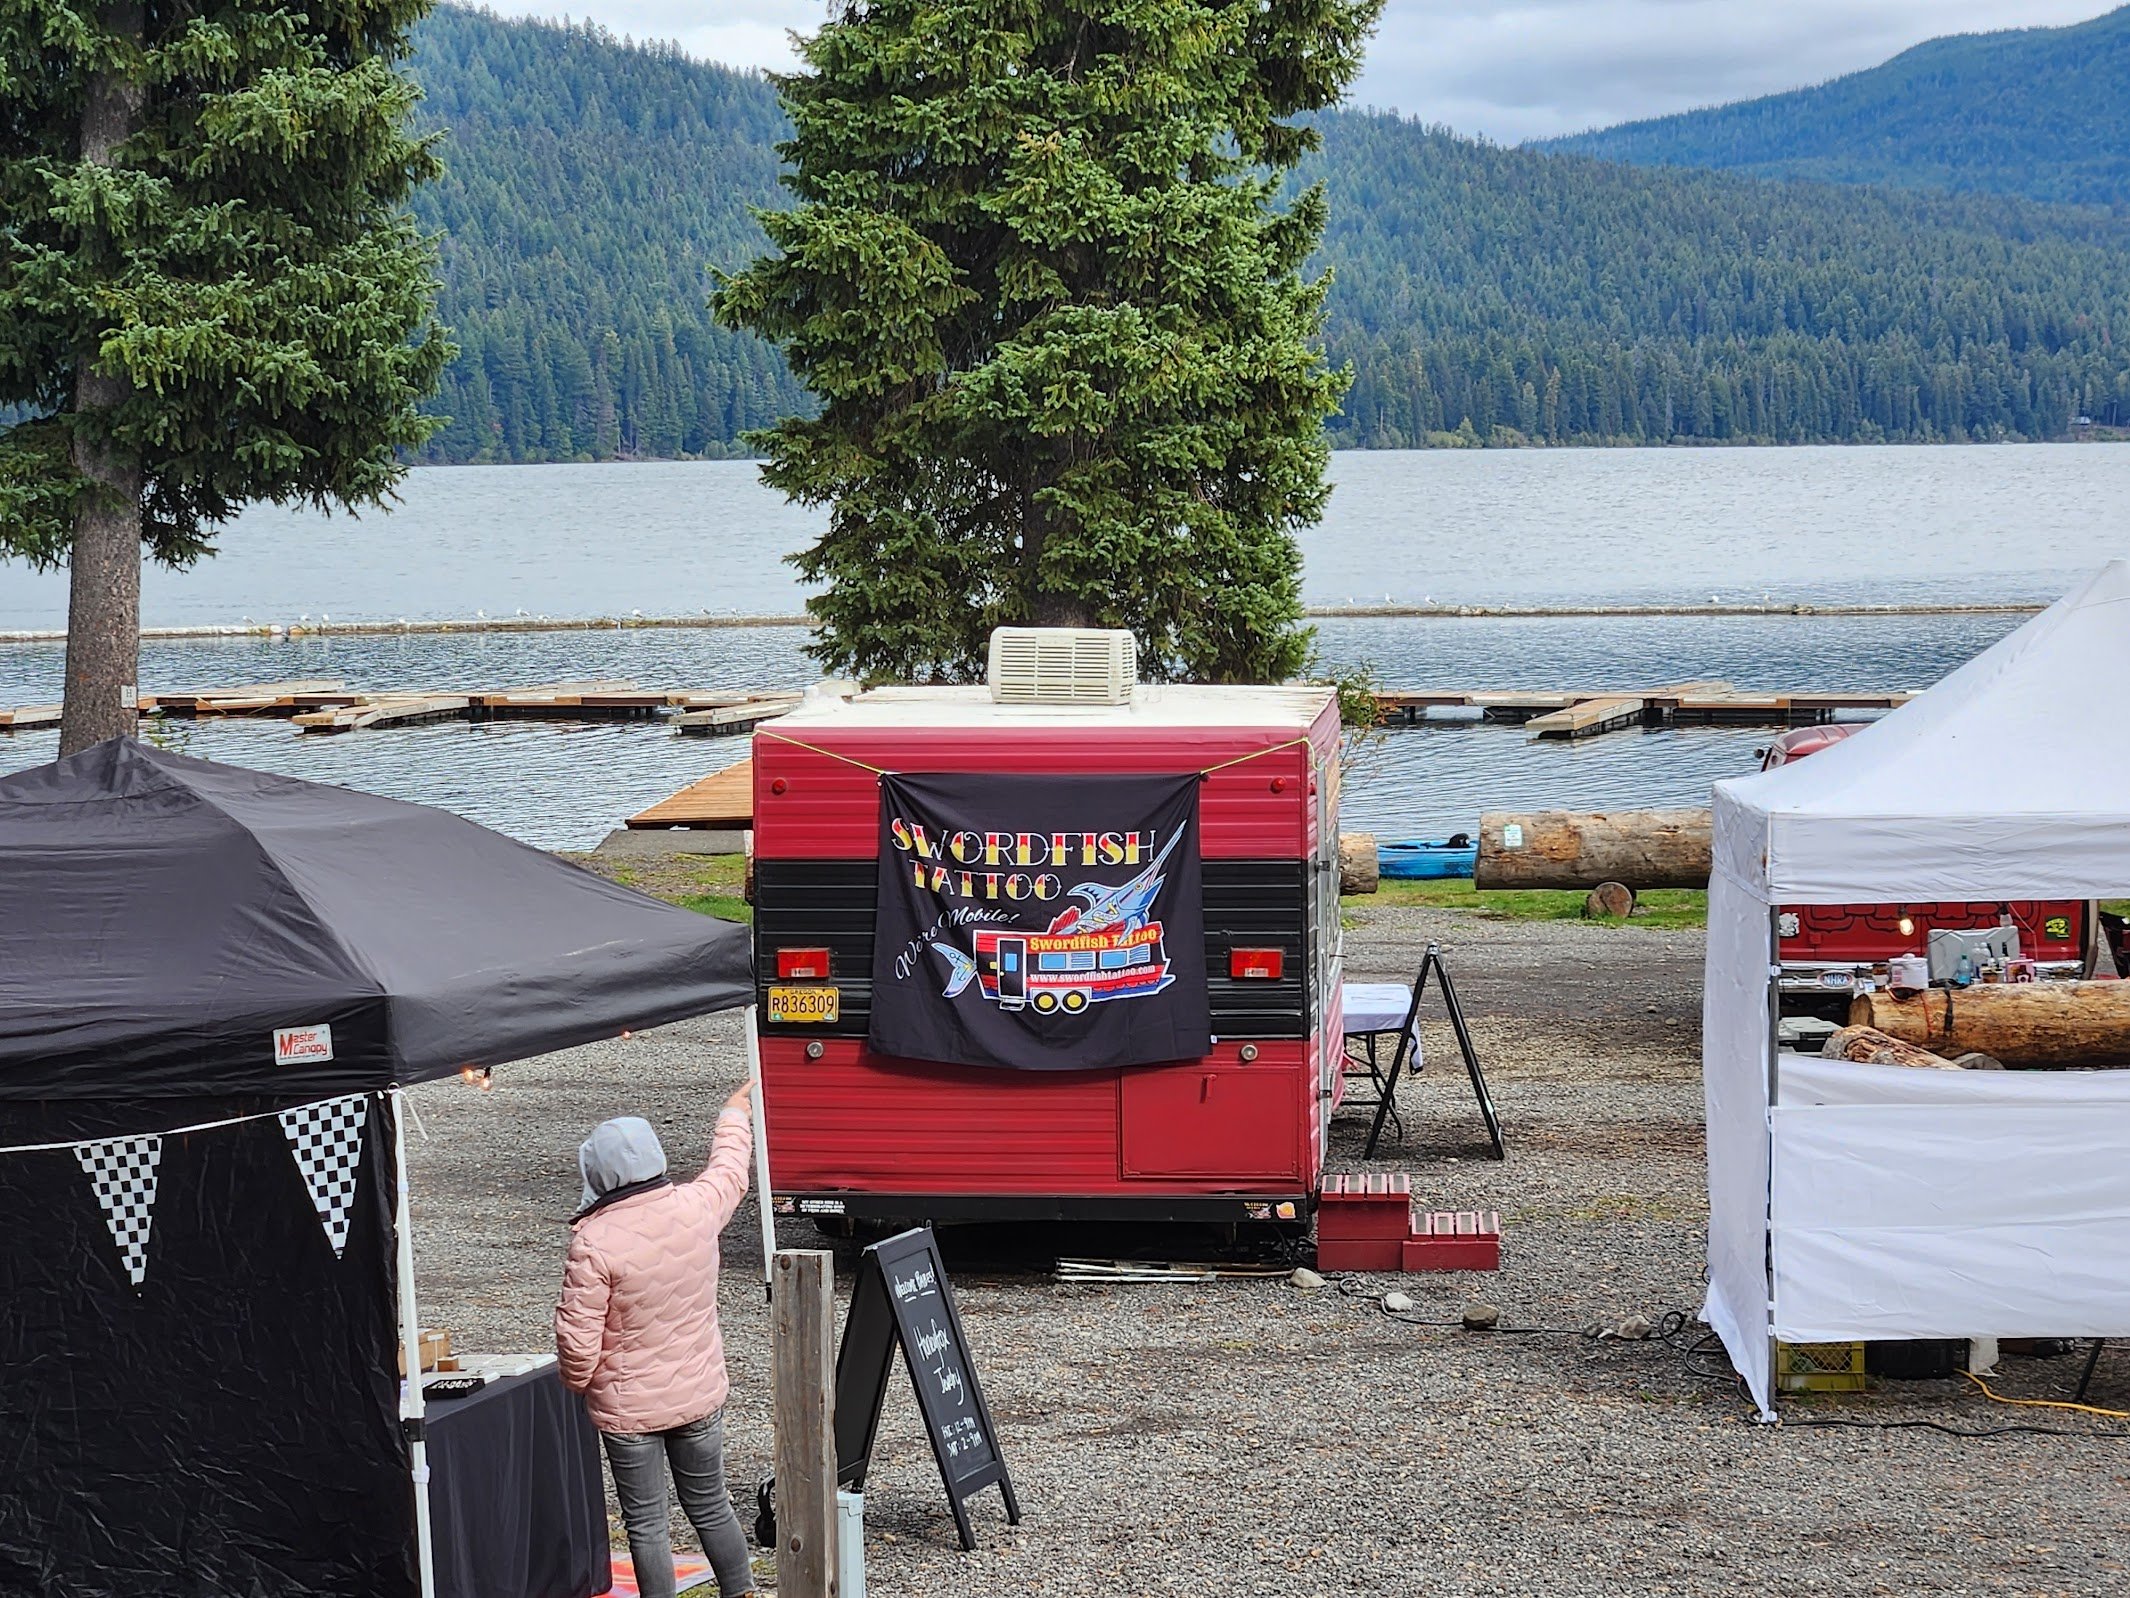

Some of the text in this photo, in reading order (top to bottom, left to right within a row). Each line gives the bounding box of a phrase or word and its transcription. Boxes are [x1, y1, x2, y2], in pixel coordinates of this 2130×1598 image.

[891, 817, 1157, 866] SWORDFISH
[908, 859, 1062, 901] TATTOO
[937, 906, 1021, 928] Mobile!
[1030, 935, 1108, 951] Swordfish
[1030, 964, 1156, 982] www.swordfishtattoo.com
[1824, 973, 1849, 985] NHRA
[772, 995, 834, 1013] R836309
[293, 1043, 328, 1055] Canopy
